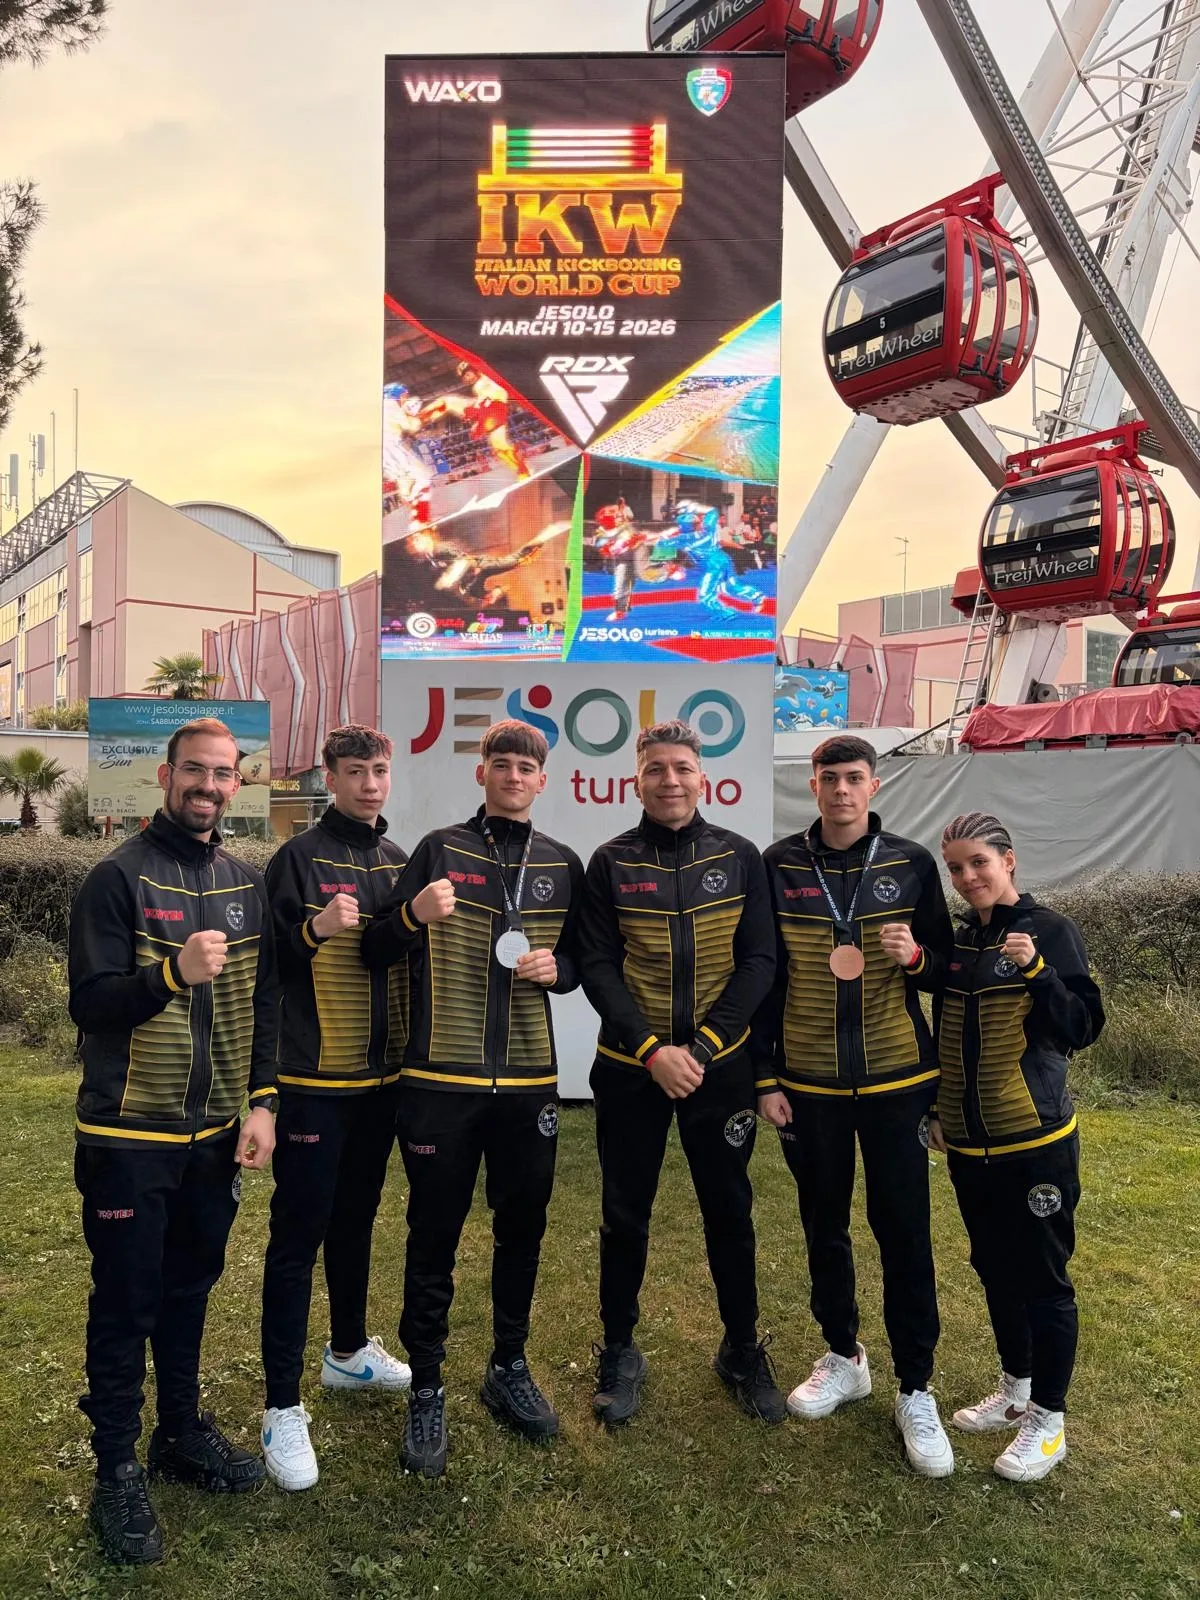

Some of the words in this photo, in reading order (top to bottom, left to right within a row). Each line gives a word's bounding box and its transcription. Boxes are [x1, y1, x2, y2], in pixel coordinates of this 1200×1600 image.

[404, 80, 502, 102] WAKO
[477, 192, 683, 254] IKW
[475, 258, 551, 272] ITALIAN
[556, 258, 682, 272] KICKBOXING
[475, 274, 603, 296] WORLD
[607, 273, 681, 296] CUP
[535, 304, 615, 320] JESOLO
[480, 320, 561, 336] MARCH
[562, 320, 615, 336] 10-15
[619, 320, 676, 336] 2026
[880, 317, 886, 328] 5
[539, 356, 635, 372] RDX
[1036, 542, 1042, 552] 4
[579, 627, 643, 642] JESOLO
[645, 628, 678, 637] turismo
[102, 745, 158, 755] EXCLUSIVE
[99, 755, 132, 769] Sun
[570, 769, 742, 806] turo
